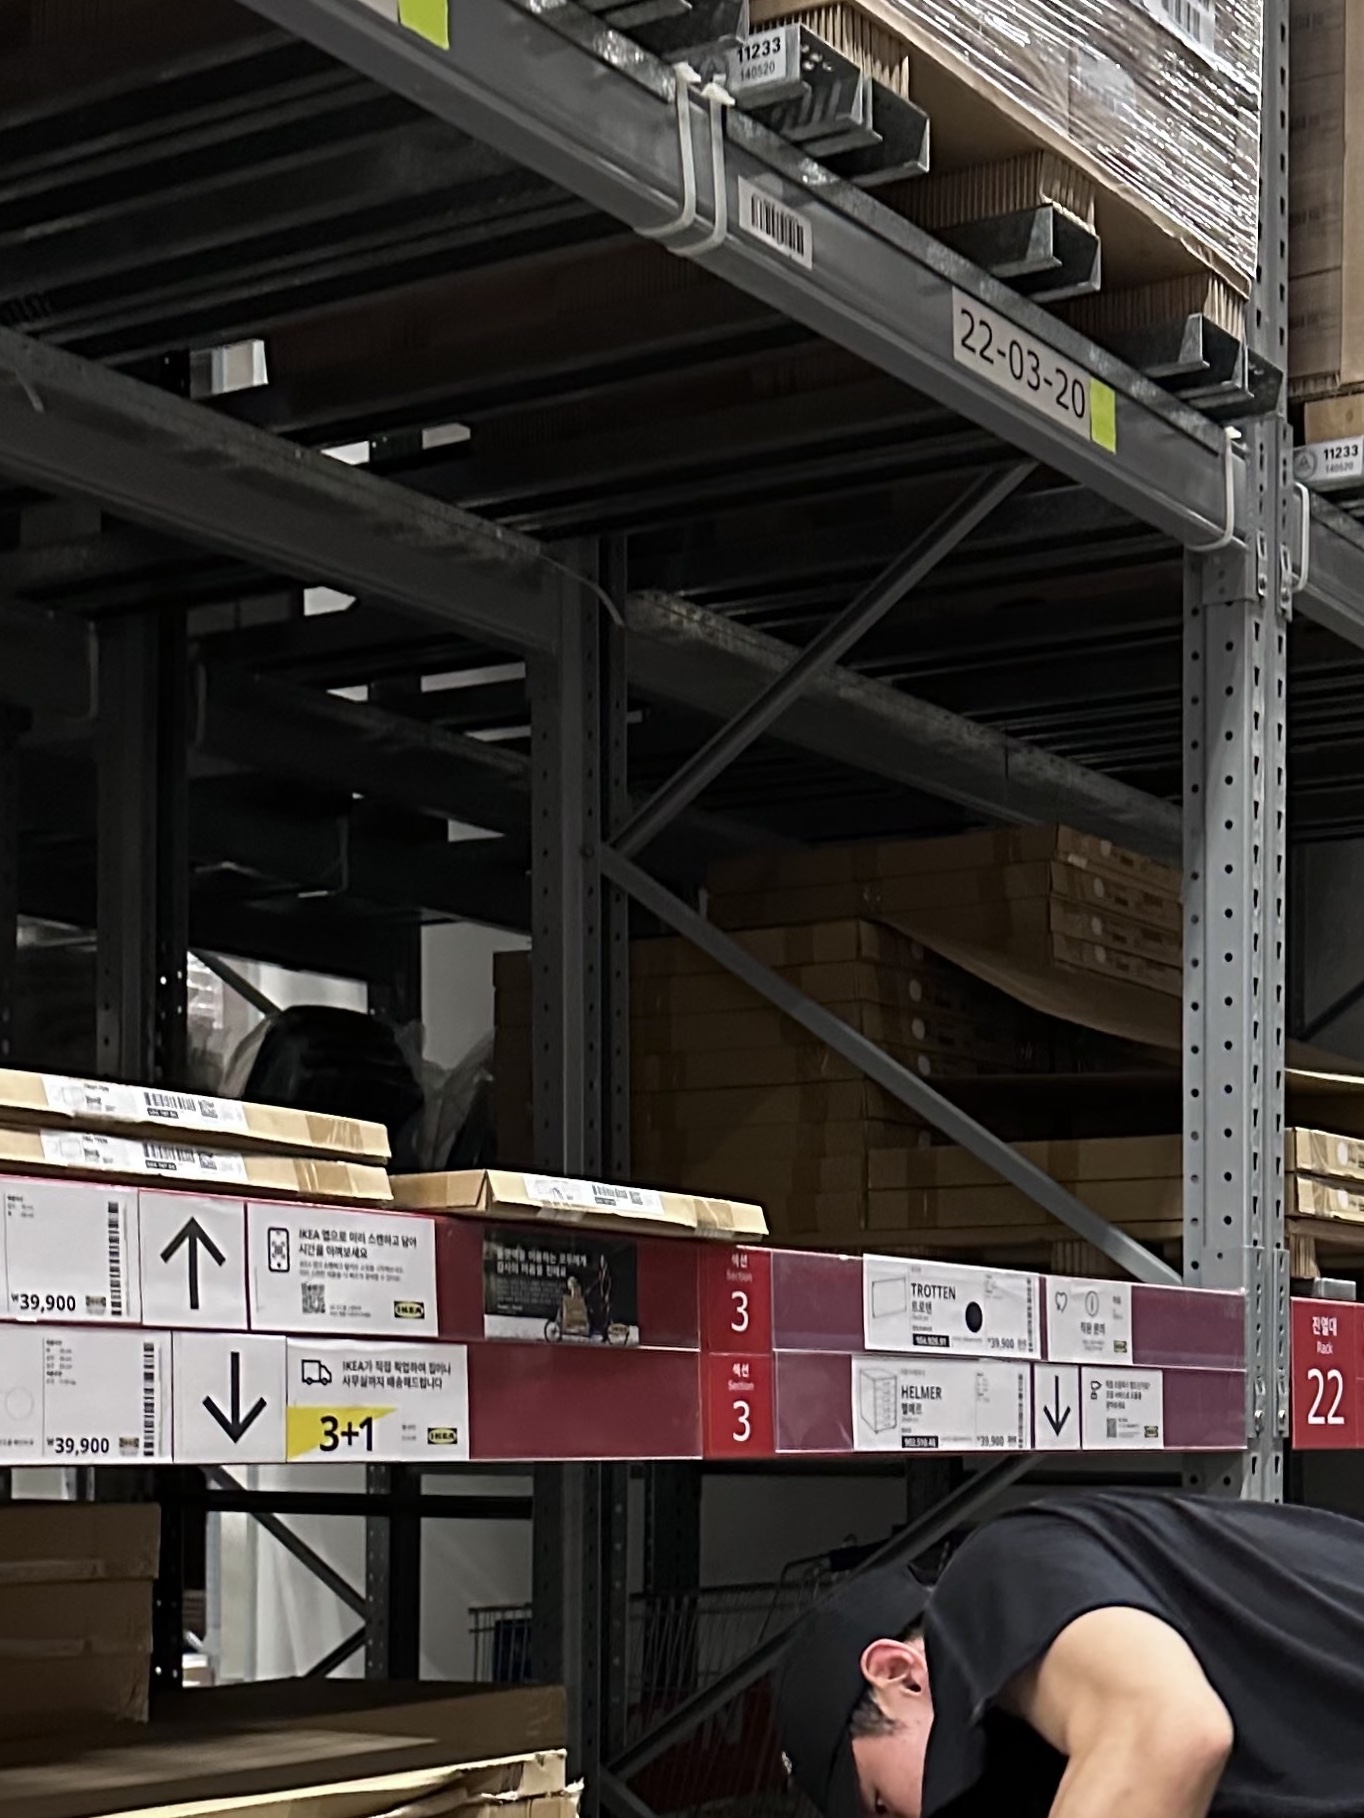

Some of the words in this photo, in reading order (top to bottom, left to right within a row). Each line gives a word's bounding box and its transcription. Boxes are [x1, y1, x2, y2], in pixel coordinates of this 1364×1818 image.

[738, 37, 780, 63] 11233
[740, 61, 776, 80] 140520
[961, 308, 1085, 418] 22-03-20
[1324, 445, 1358, 460] 11233
[299, 1228, 320, 1240] IKEA
[911, 1283, 956, 1300] TROTTEN
[396, 1304, 422, 1316] IKEA
[731, 1290, 749, 1332] 3
[1317, 1341, 1333, 1354] Rack
[728, 1379, 755, 1391] Section
[902, 1386, 942, 1400] HELMER
[1307, 1368, 1345, 1424] 22
[732, 1400, 750, 1442] 3
[320, 1415, 373, 1451] 3+1
